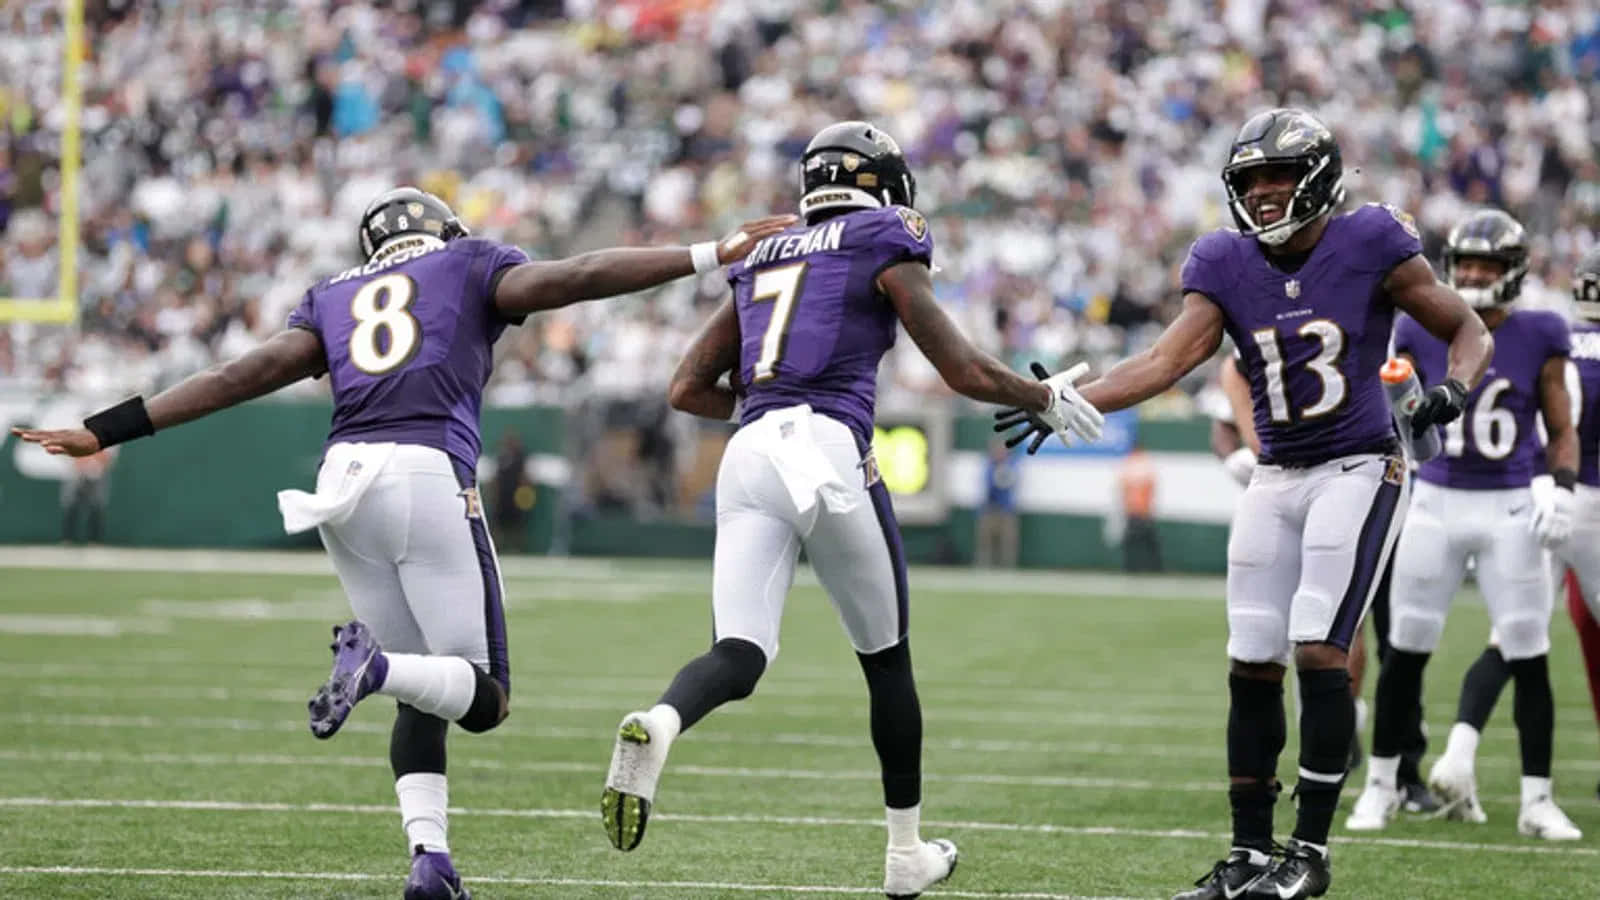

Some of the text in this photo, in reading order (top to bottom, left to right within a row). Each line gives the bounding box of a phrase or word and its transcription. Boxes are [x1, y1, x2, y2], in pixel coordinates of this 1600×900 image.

[398, 214, 408, 230] 8
[829, 165, 838, 182] 7
[350, 272, 420, 375] 8
[752, 263, 809, 382] 7
[1253, 319, 1347, 424] 13
